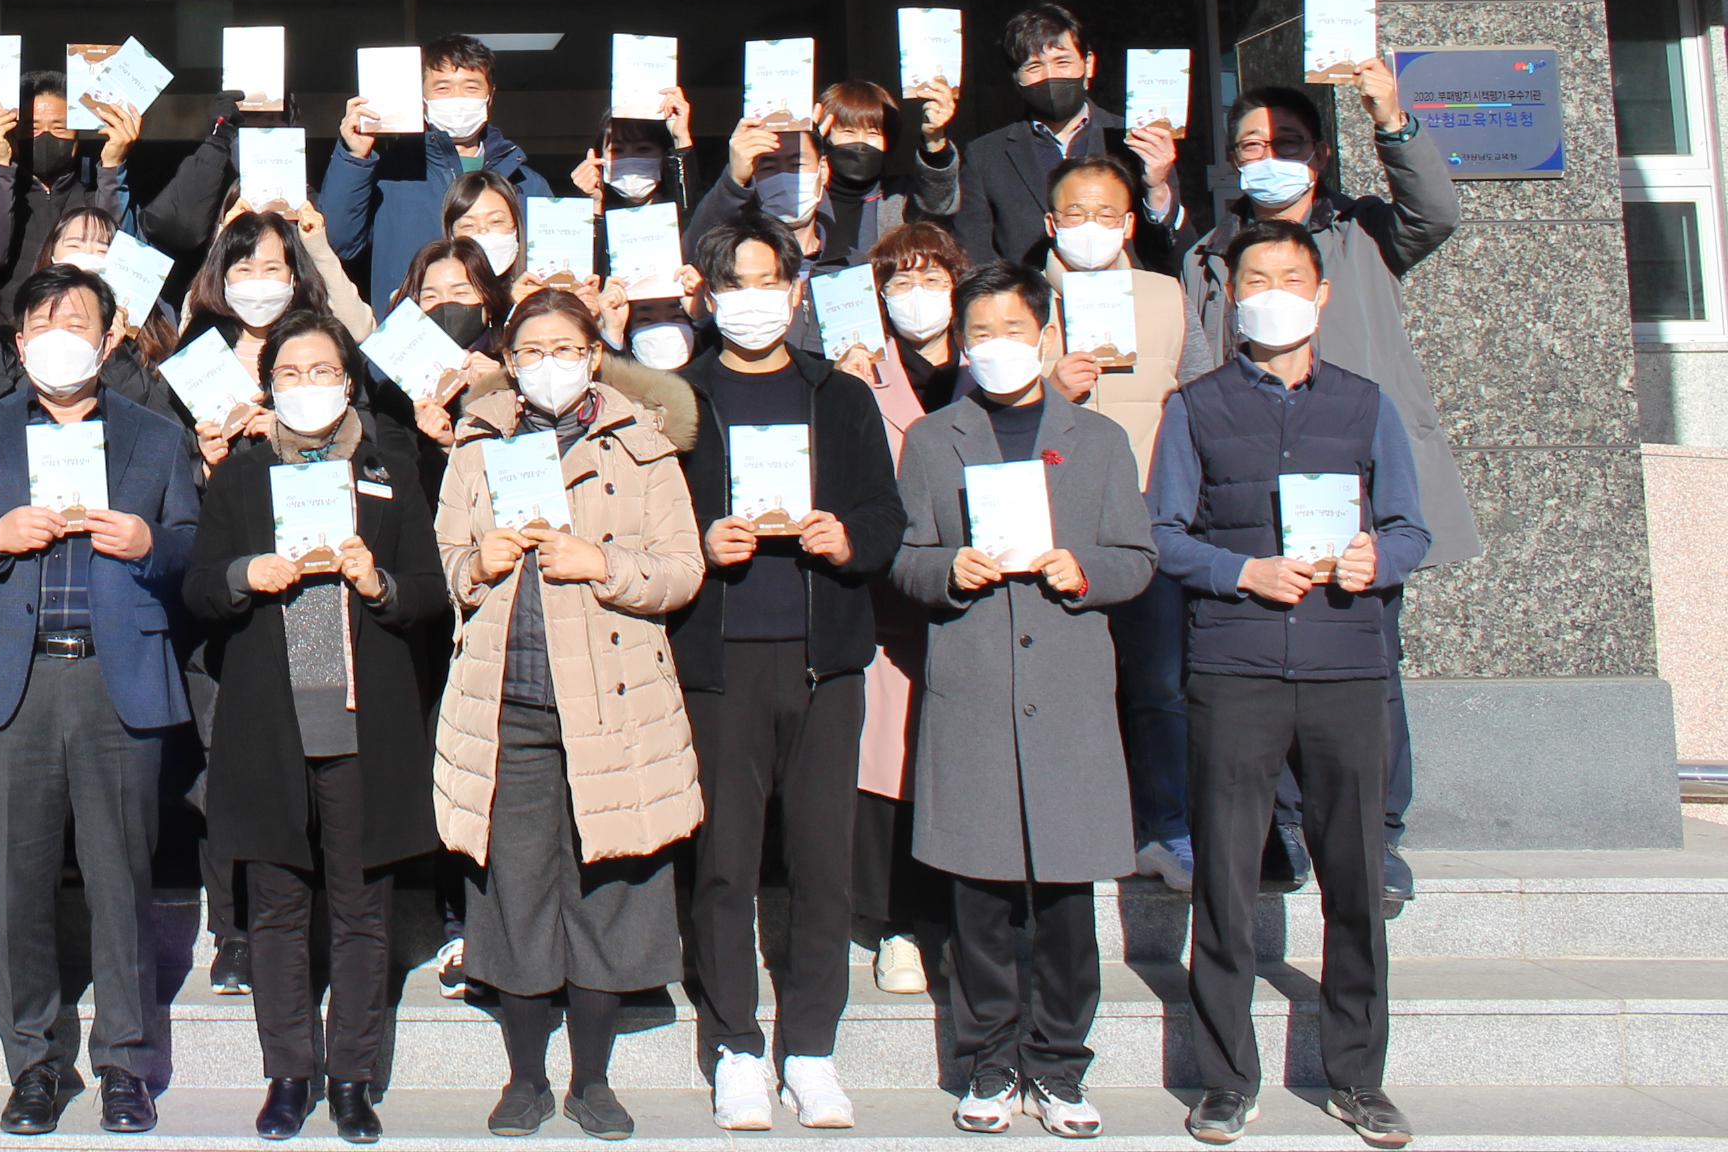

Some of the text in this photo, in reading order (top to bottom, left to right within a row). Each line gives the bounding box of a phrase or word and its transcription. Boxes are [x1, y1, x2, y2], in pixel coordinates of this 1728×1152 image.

[1438, 91, 1472, 102] 부패방지
[1473, 91, 1506, 101] 시책평가
[1507, 90, 1542, 101] 우수기관
[1427, 111, 1533, 128] 산청교육지원청
